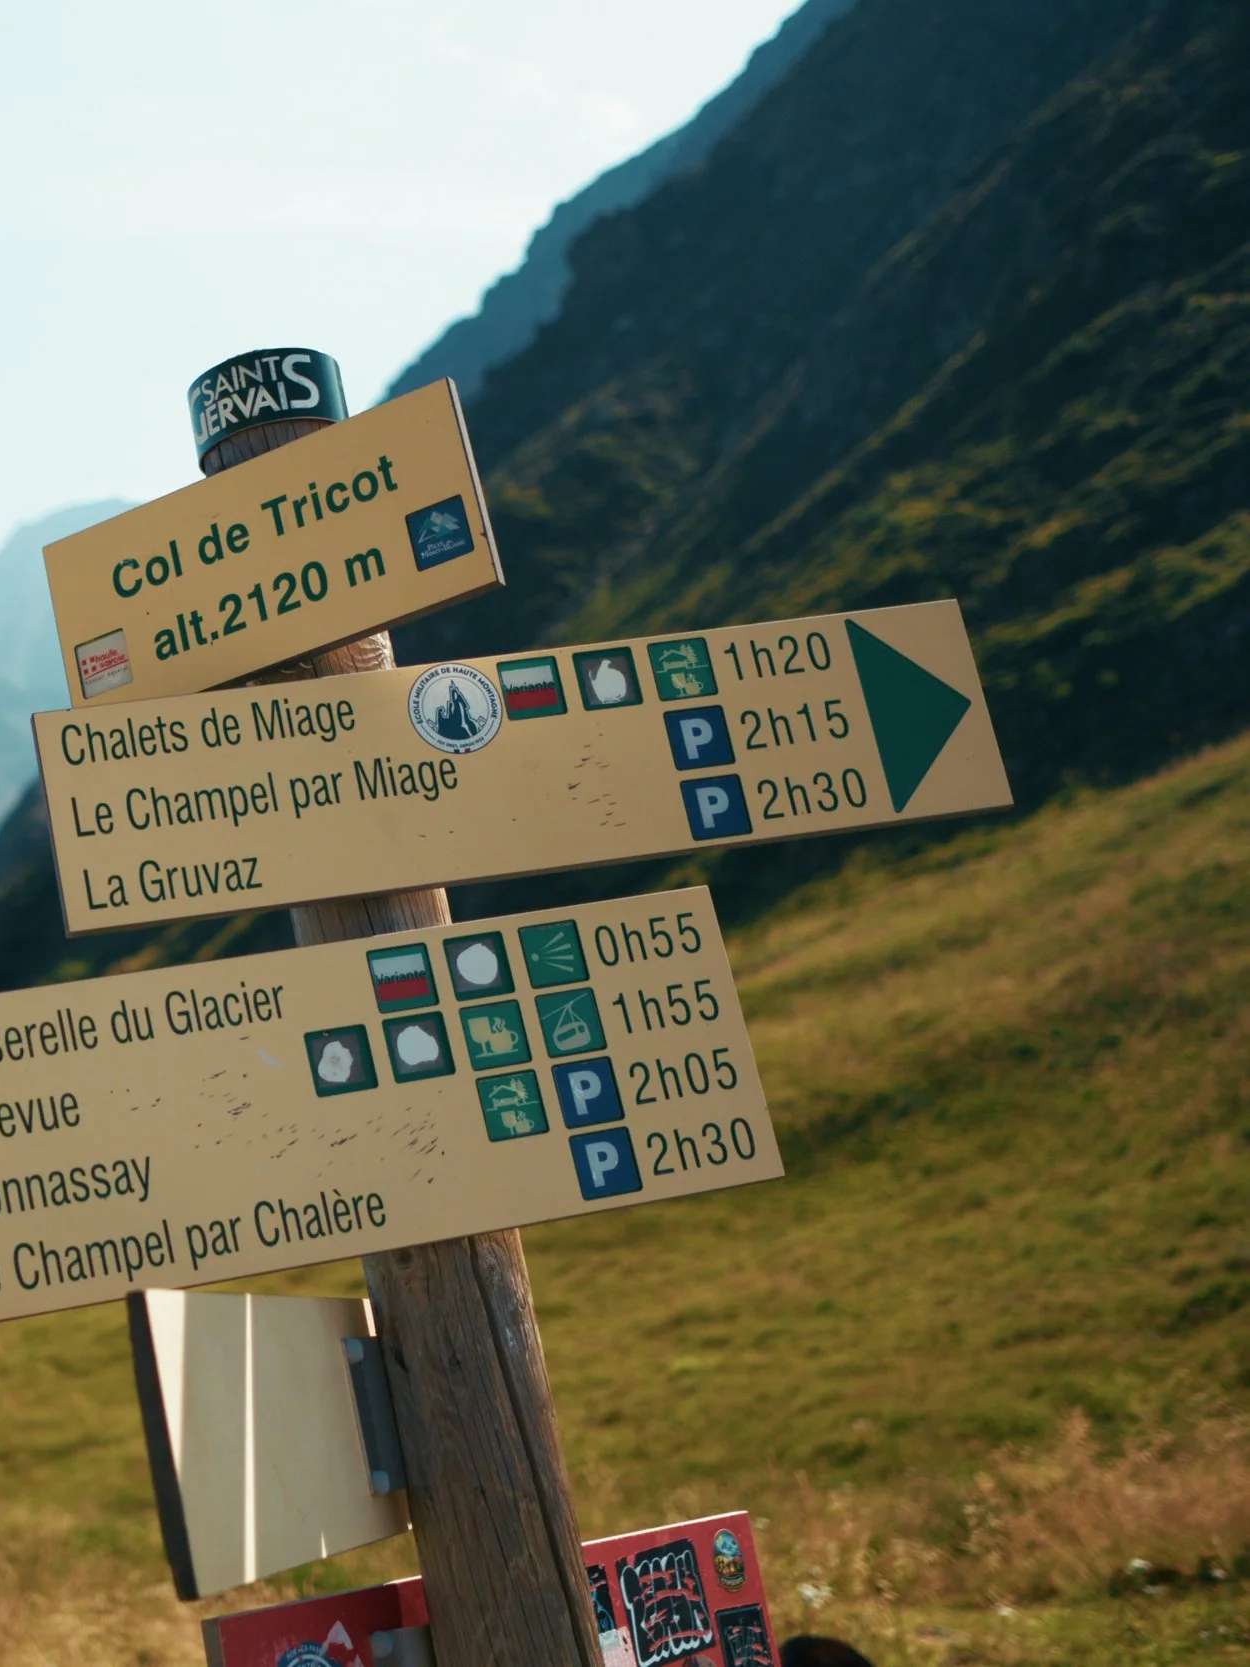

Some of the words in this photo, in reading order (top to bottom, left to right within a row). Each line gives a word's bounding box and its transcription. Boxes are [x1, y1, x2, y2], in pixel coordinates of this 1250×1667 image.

[201, 356, 280, 407] SAINT
[113, 540, 182, 597] Col
[199, 523, 249, 564] de
[261, 456, 398, 536] Tricot
[154, 562, 327, 660] alt.2120
[344, 548, 385, 587] m
[724, 632, 830, 680] 1h20
[414, 669, 440, 699] MILITAIRE
[452, 667, 479, 680] HAUTE
[478, 678, 499, 719] MONTAGNE
[503, 680, 555, 695] Variante
[62, 716, 188, 765] Chalets
[201, 708, 240, 747] de
[251, 700, 354, 742] Miage
[679, 718, 713, 760] P
[741, 700, 849, 749] 2h15
[71, 797, 113, 837] Le
[126, 772, 278, 830] Champel
[290, 773, 342, 818] par
[354, 758, 457, 801] Miage
[695, 786, 729, 829] P
[758, 769, 866, 819] 2h30
[83, 870, 129, 910] La
[139, 857, 262, 902] Gruvaz
[595, 913, 701, 966] 0h55
[374, 970, 427, 985] Variante
[613, 980, 718, 1033] 1h55
[111, 1003, 154, 1043] du
[166, 981, 284, 1036] Glacier
[568, 1070, 601, 1116] P
[629, 1048, 737, 1105] 2h05
[585, 1140, 619, 1188] P
[647, 1118, 755, 1176] 2h30
[14, 1220, 174, 1289] Champel
[186, 1217, 240, 1270] par
[254, 1189, 385, 1247] Chalère
